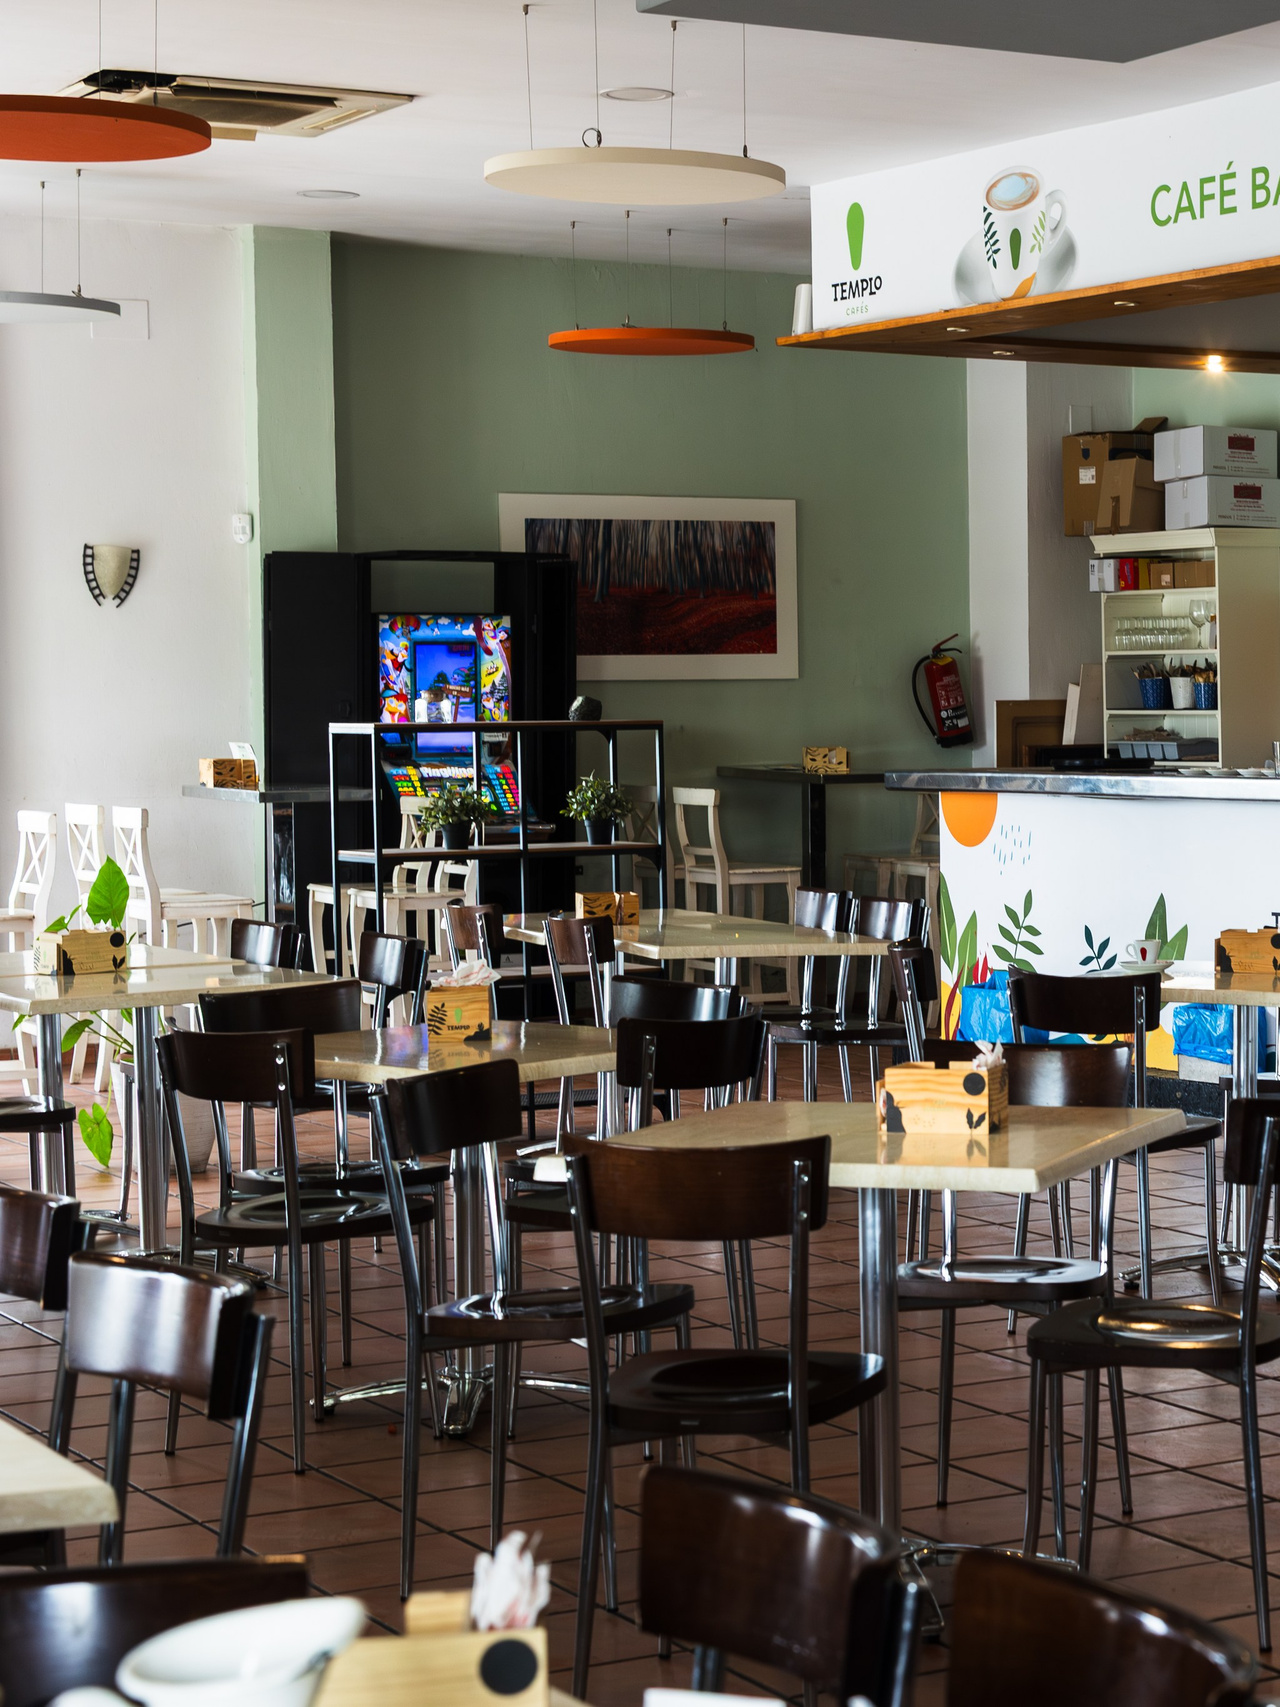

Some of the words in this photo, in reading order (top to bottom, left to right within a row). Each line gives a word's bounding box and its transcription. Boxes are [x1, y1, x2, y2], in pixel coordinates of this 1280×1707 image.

[1150, 160, 1238, 227] CAFÉ
[831, 275, 883, 302] TEMPLO
[845, 301, 869, 316] CAFÉS
